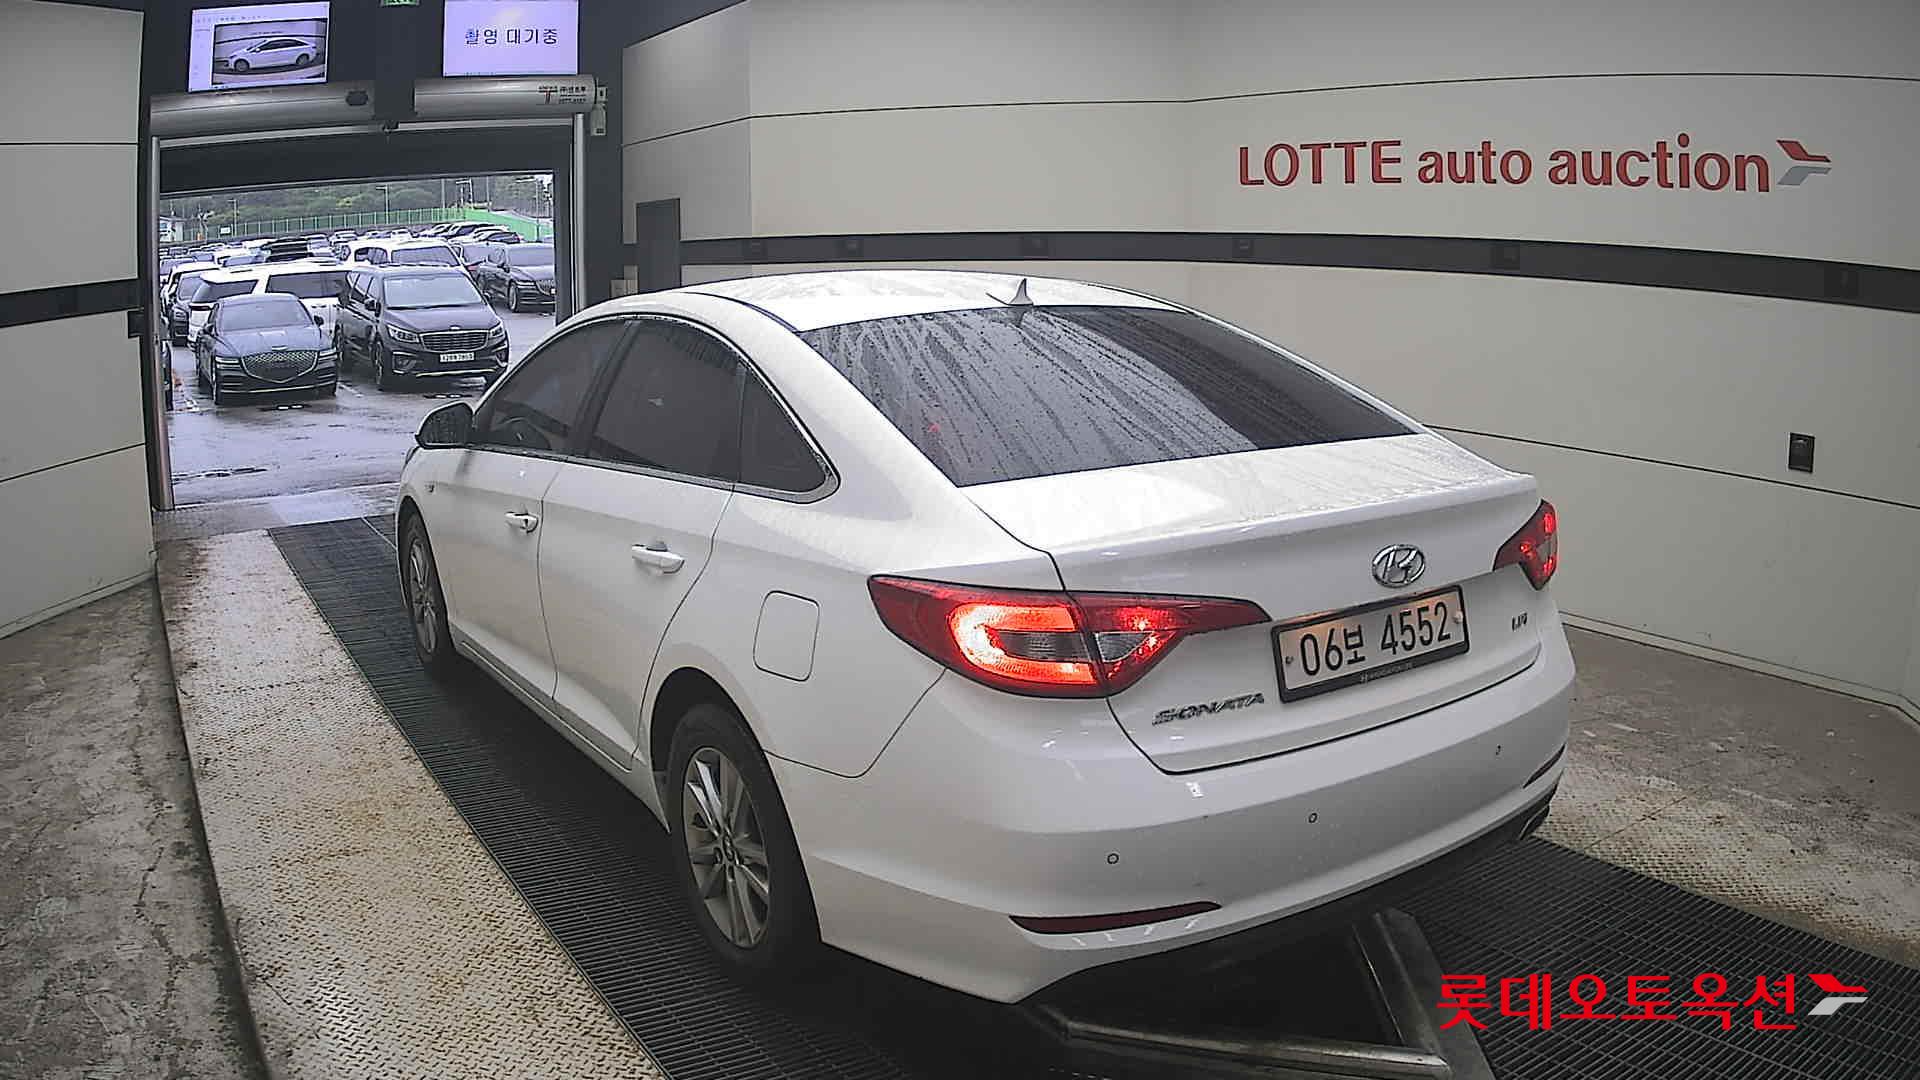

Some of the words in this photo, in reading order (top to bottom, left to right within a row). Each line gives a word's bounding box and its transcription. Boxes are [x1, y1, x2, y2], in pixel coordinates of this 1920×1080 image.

[465, 28, 498, 45] 촬영
[506, 28, 558, 45] 대기중
[1238, 139, 1403, 187] LOTTE
[1416, 140, 1533, 186] auto
[1547, 132, 1770, 192] auction
[1299, 623, 1366, 674] 06보
[1380, 601, 1451, 655] 4552
[1152, 693, 1264, 725] SONATA
